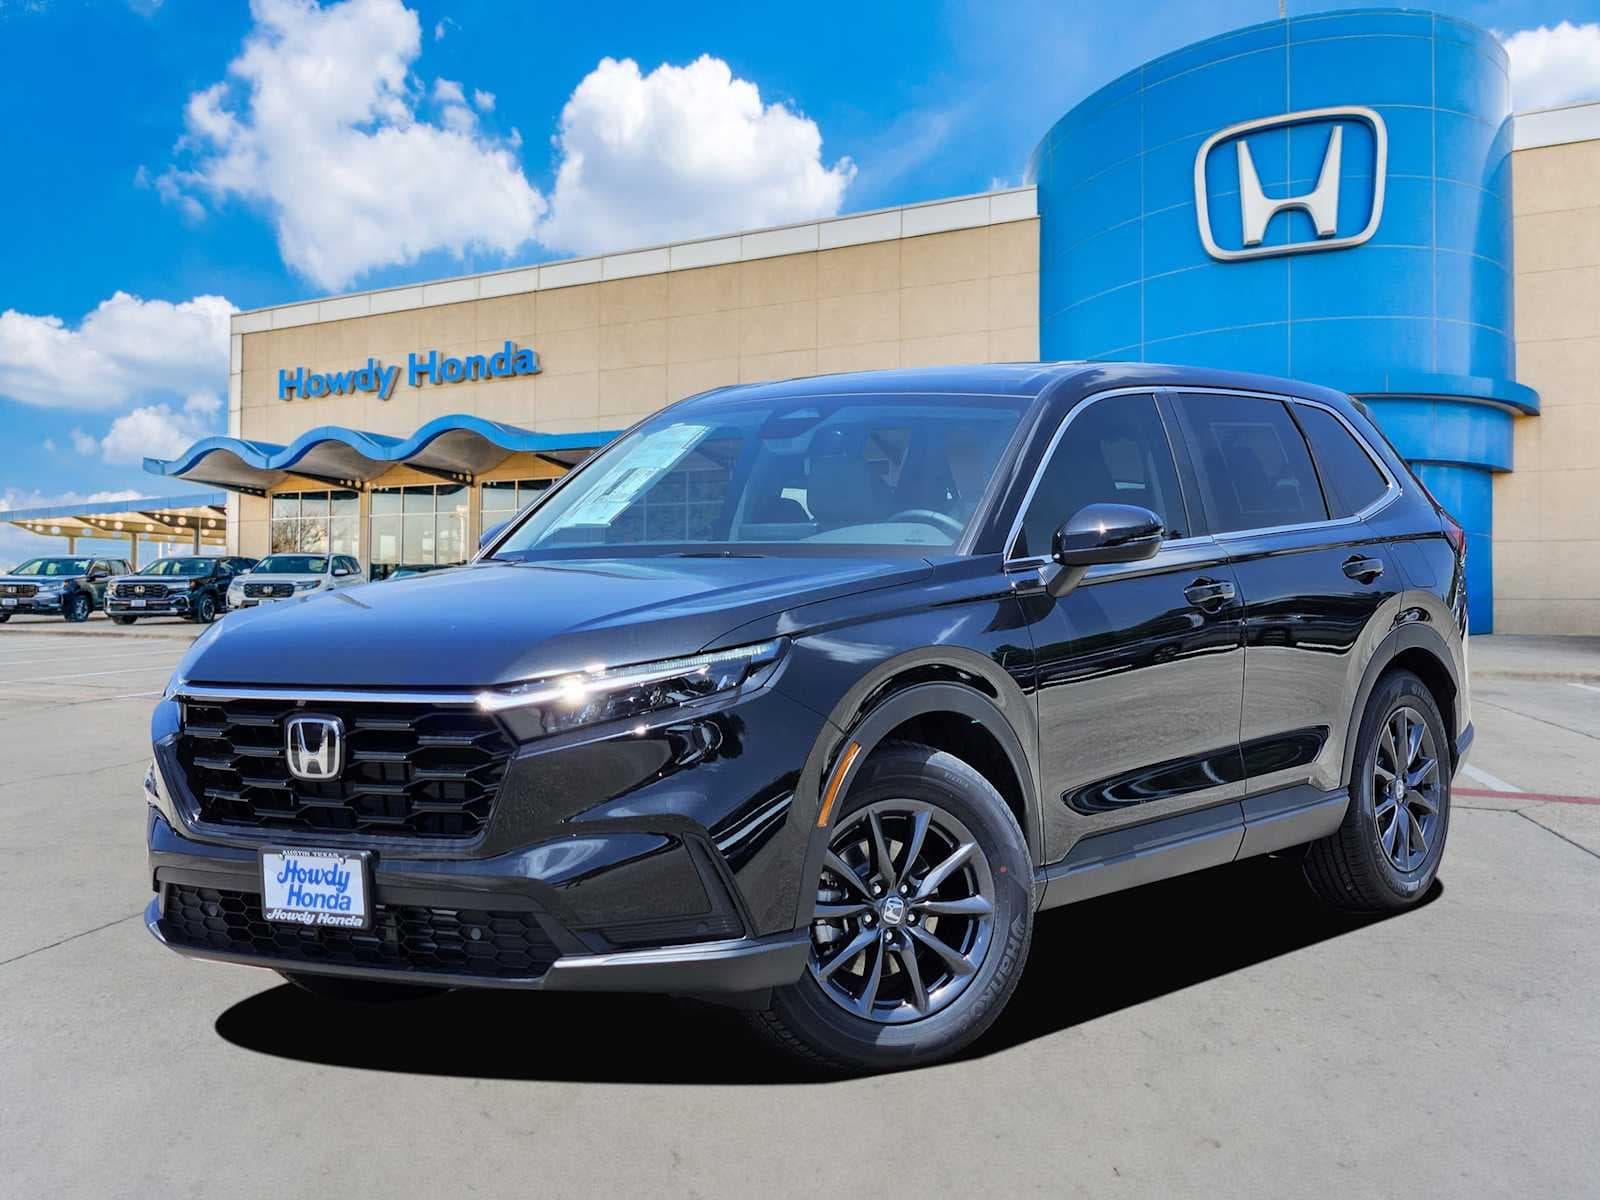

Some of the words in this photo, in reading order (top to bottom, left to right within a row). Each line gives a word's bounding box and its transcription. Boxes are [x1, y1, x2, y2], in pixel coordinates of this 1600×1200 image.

[278, 357, 402, 401] Howdy
[408, 340, 543, 387] Honda
[277, 859, 351, 893] Howdy
[286, 884, 352, 911] Honda
[266, 908, 316, 925] Howdy
[316, 912, 363, 927] Honda
